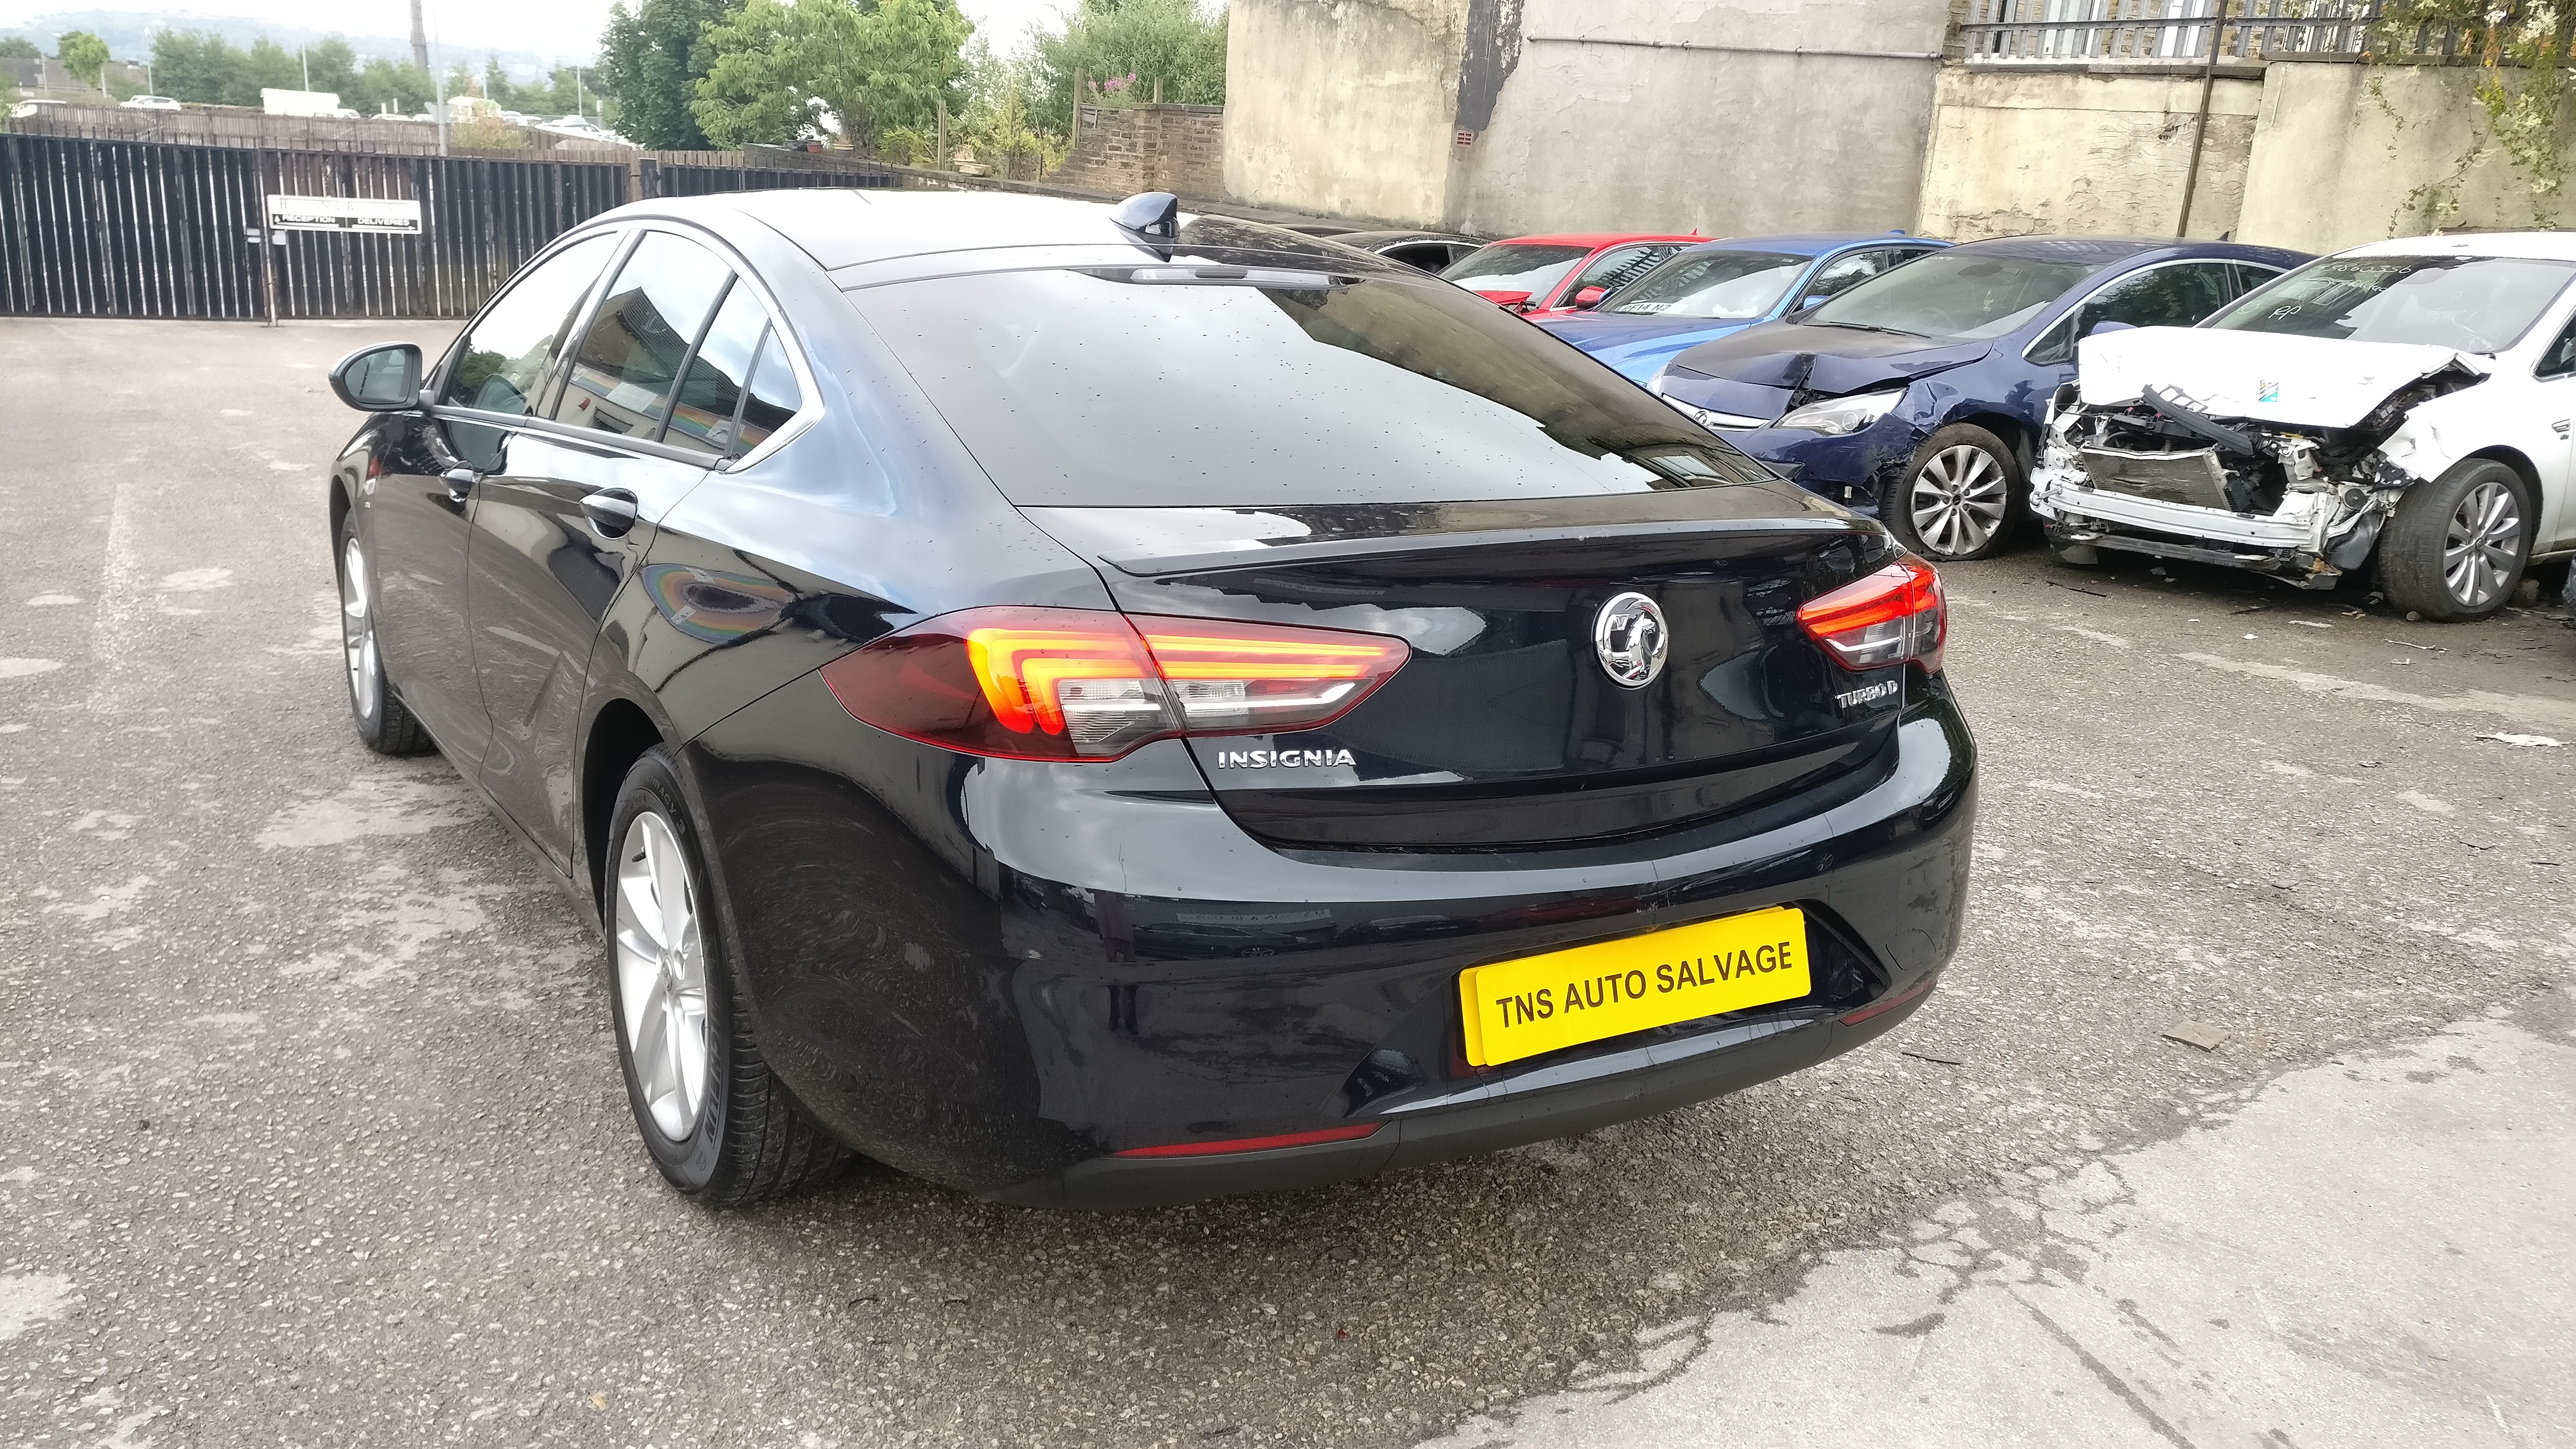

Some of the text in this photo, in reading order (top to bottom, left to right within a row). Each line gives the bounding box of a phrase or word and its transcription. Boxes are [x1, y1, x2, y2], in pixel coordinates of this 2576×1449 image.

[282, 215, 410, 226] RECEPTION DELIVERIES
[1835, 680, 1898, 709] TURBO D
[1217, 749, 1357, 769] INSIGNIA
[1496, 942, 1793, 1028] TNS AUTO SALVAGE
